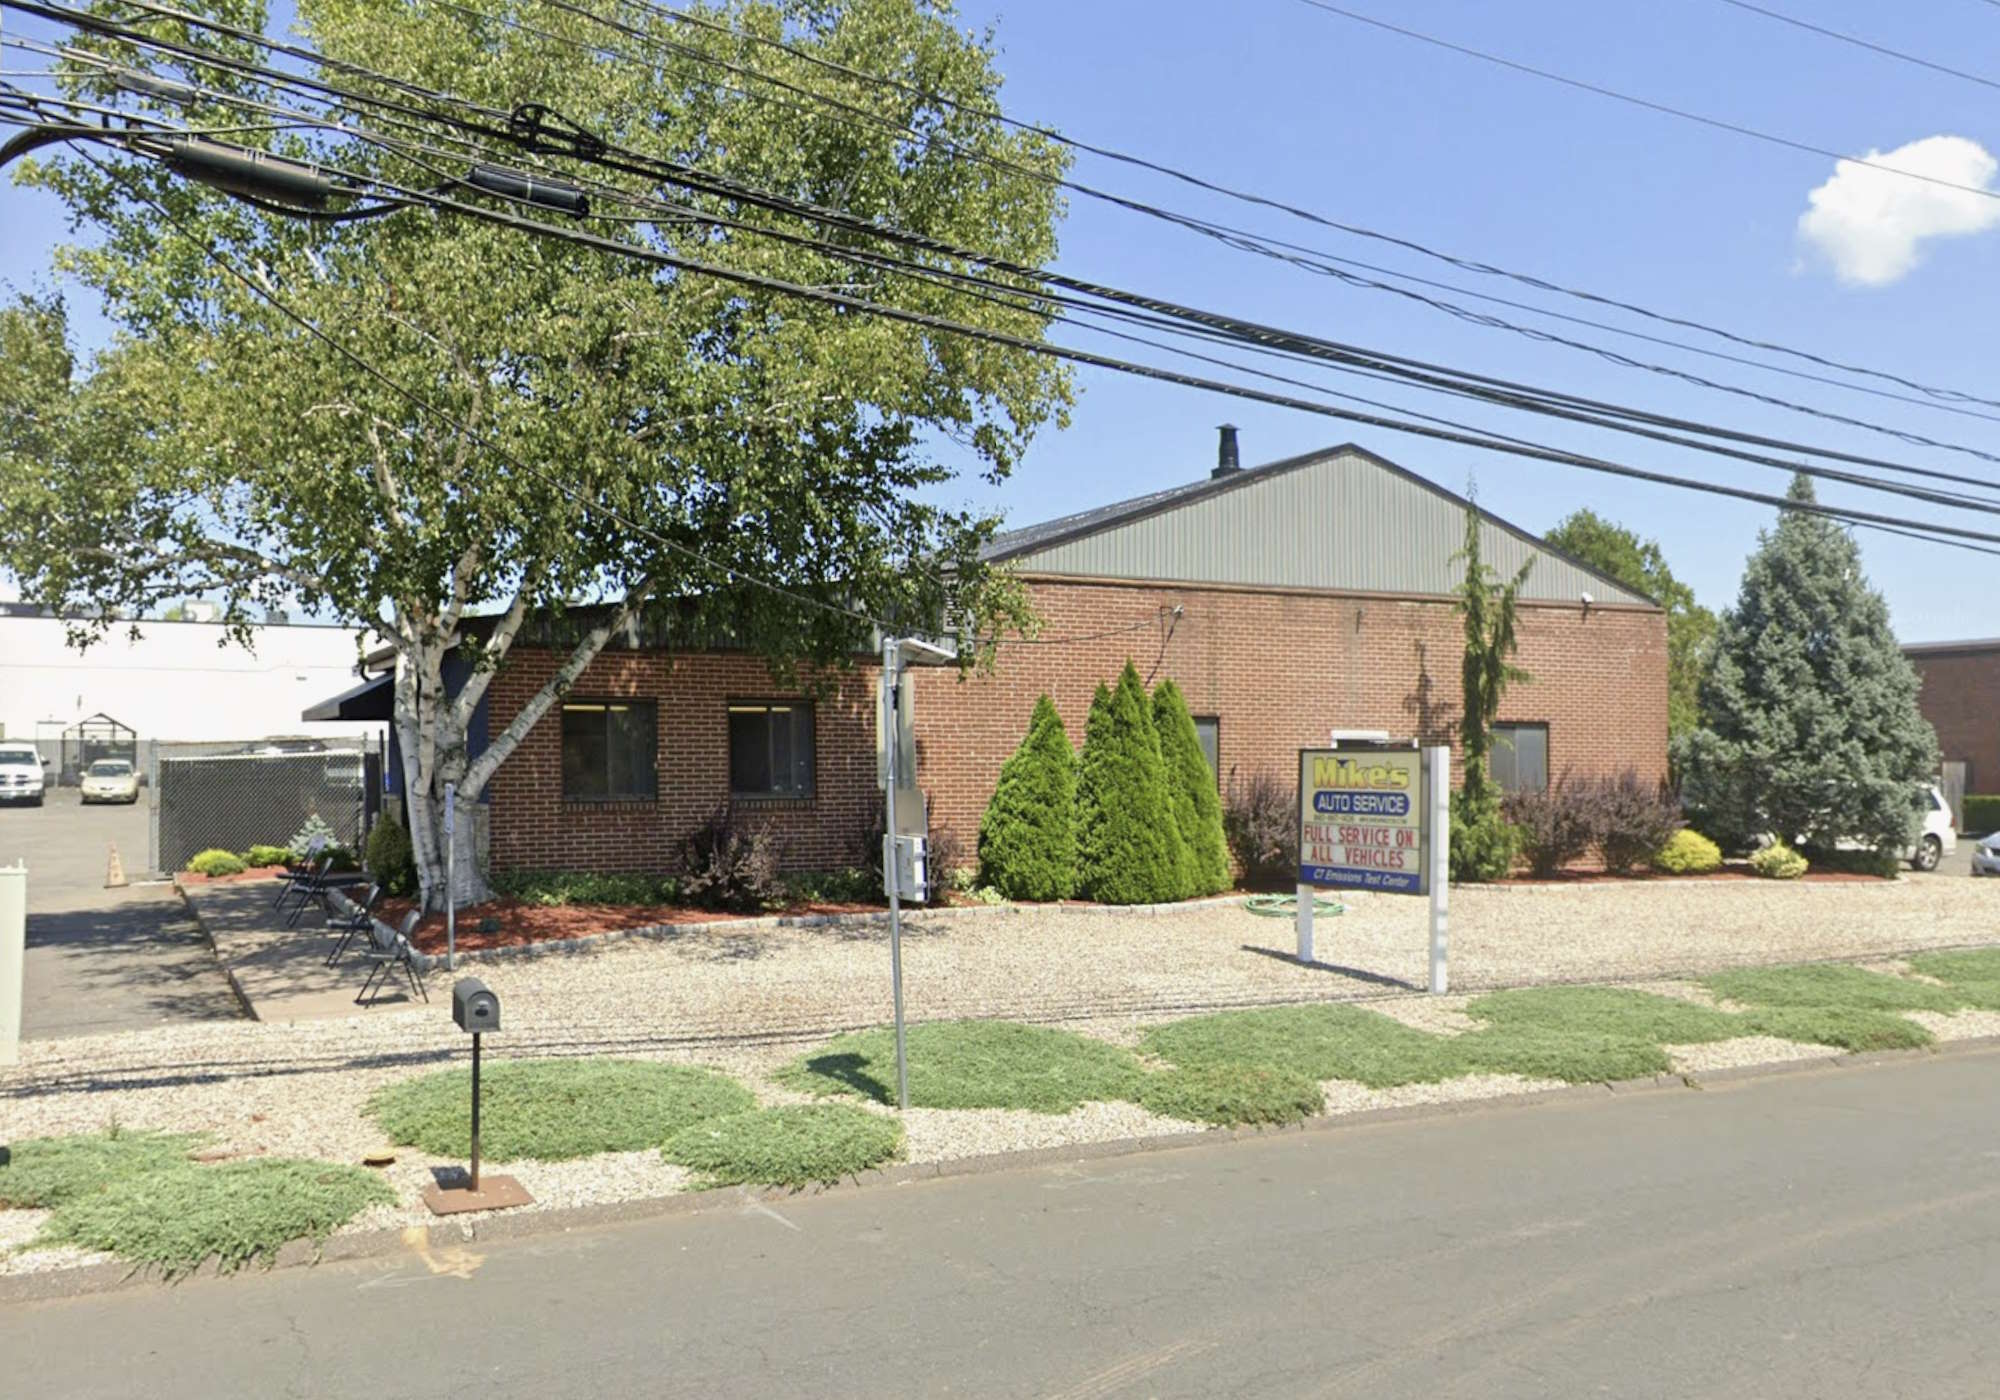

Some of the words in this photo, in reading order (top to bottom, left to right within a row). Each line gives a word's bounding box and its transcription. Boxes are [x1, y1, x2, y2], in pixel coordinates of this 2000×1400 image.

[1313, 757, 1409, 790] Mike's
[1318, 794, 1350, 811] AUTO
[1353, 795, 1405, 813] SERVICE
[1304, 824, 1332, 842] FULL
[1339, 826, 1390, 846] SERVICE
[1396, 829, 1413, 848] ON
[1311, 845, 1332, 862] ALL
[1344, 847, 1404, 869] VEHICLES
[1325, 869, 1362, 883] Emissions
[1364, 873, 1382, 885] Test
[1382, 874, 1409, 888] Center
